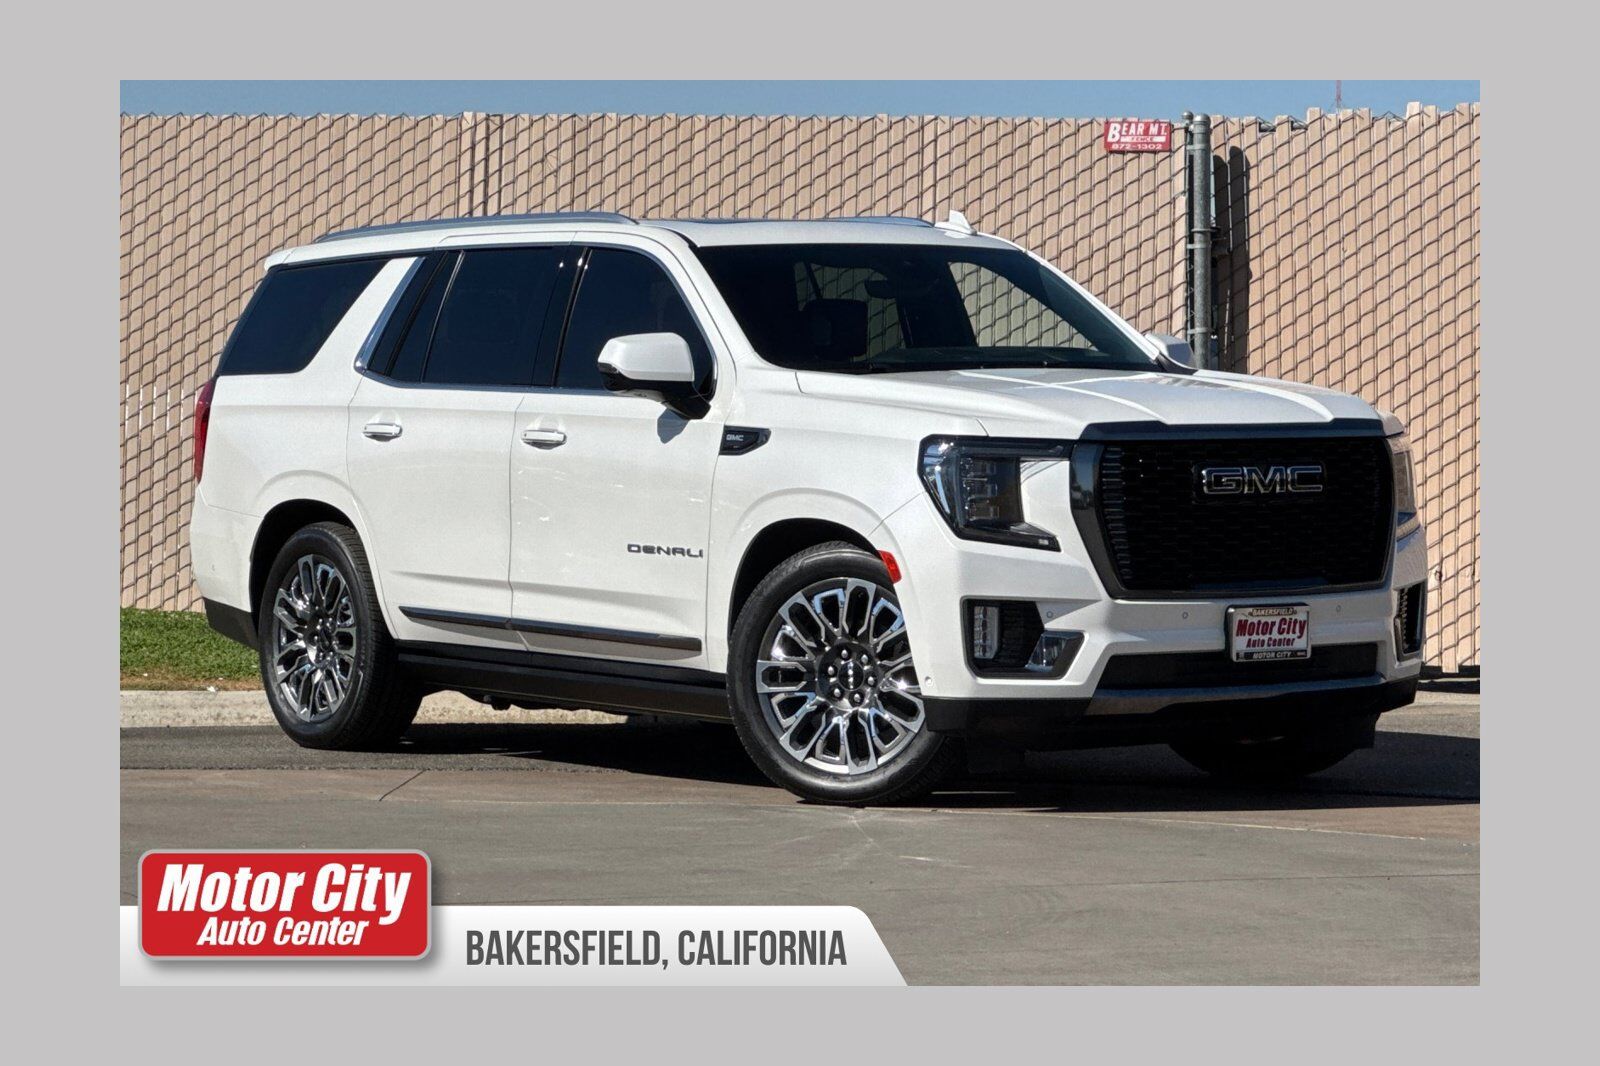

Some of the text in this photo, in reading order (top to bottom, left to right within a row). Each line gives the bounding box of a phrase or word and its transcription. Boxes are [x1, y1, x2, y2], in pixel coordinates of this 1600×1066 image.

[1107, 123, 1167, 142] BEAR MT.
[726, 433, 744, 441] GMC
[1202, 465, 1323, 494] GMC
[627, 543, 703, 558] DENALI
[1252, 608, 1293, 616] BAKERSFIELD
[1236, 617, 1307, 639] Motor City
[1246, 637, 1295, 648] Auto Center
[1252, 652, 1275, 660] MOTOR
